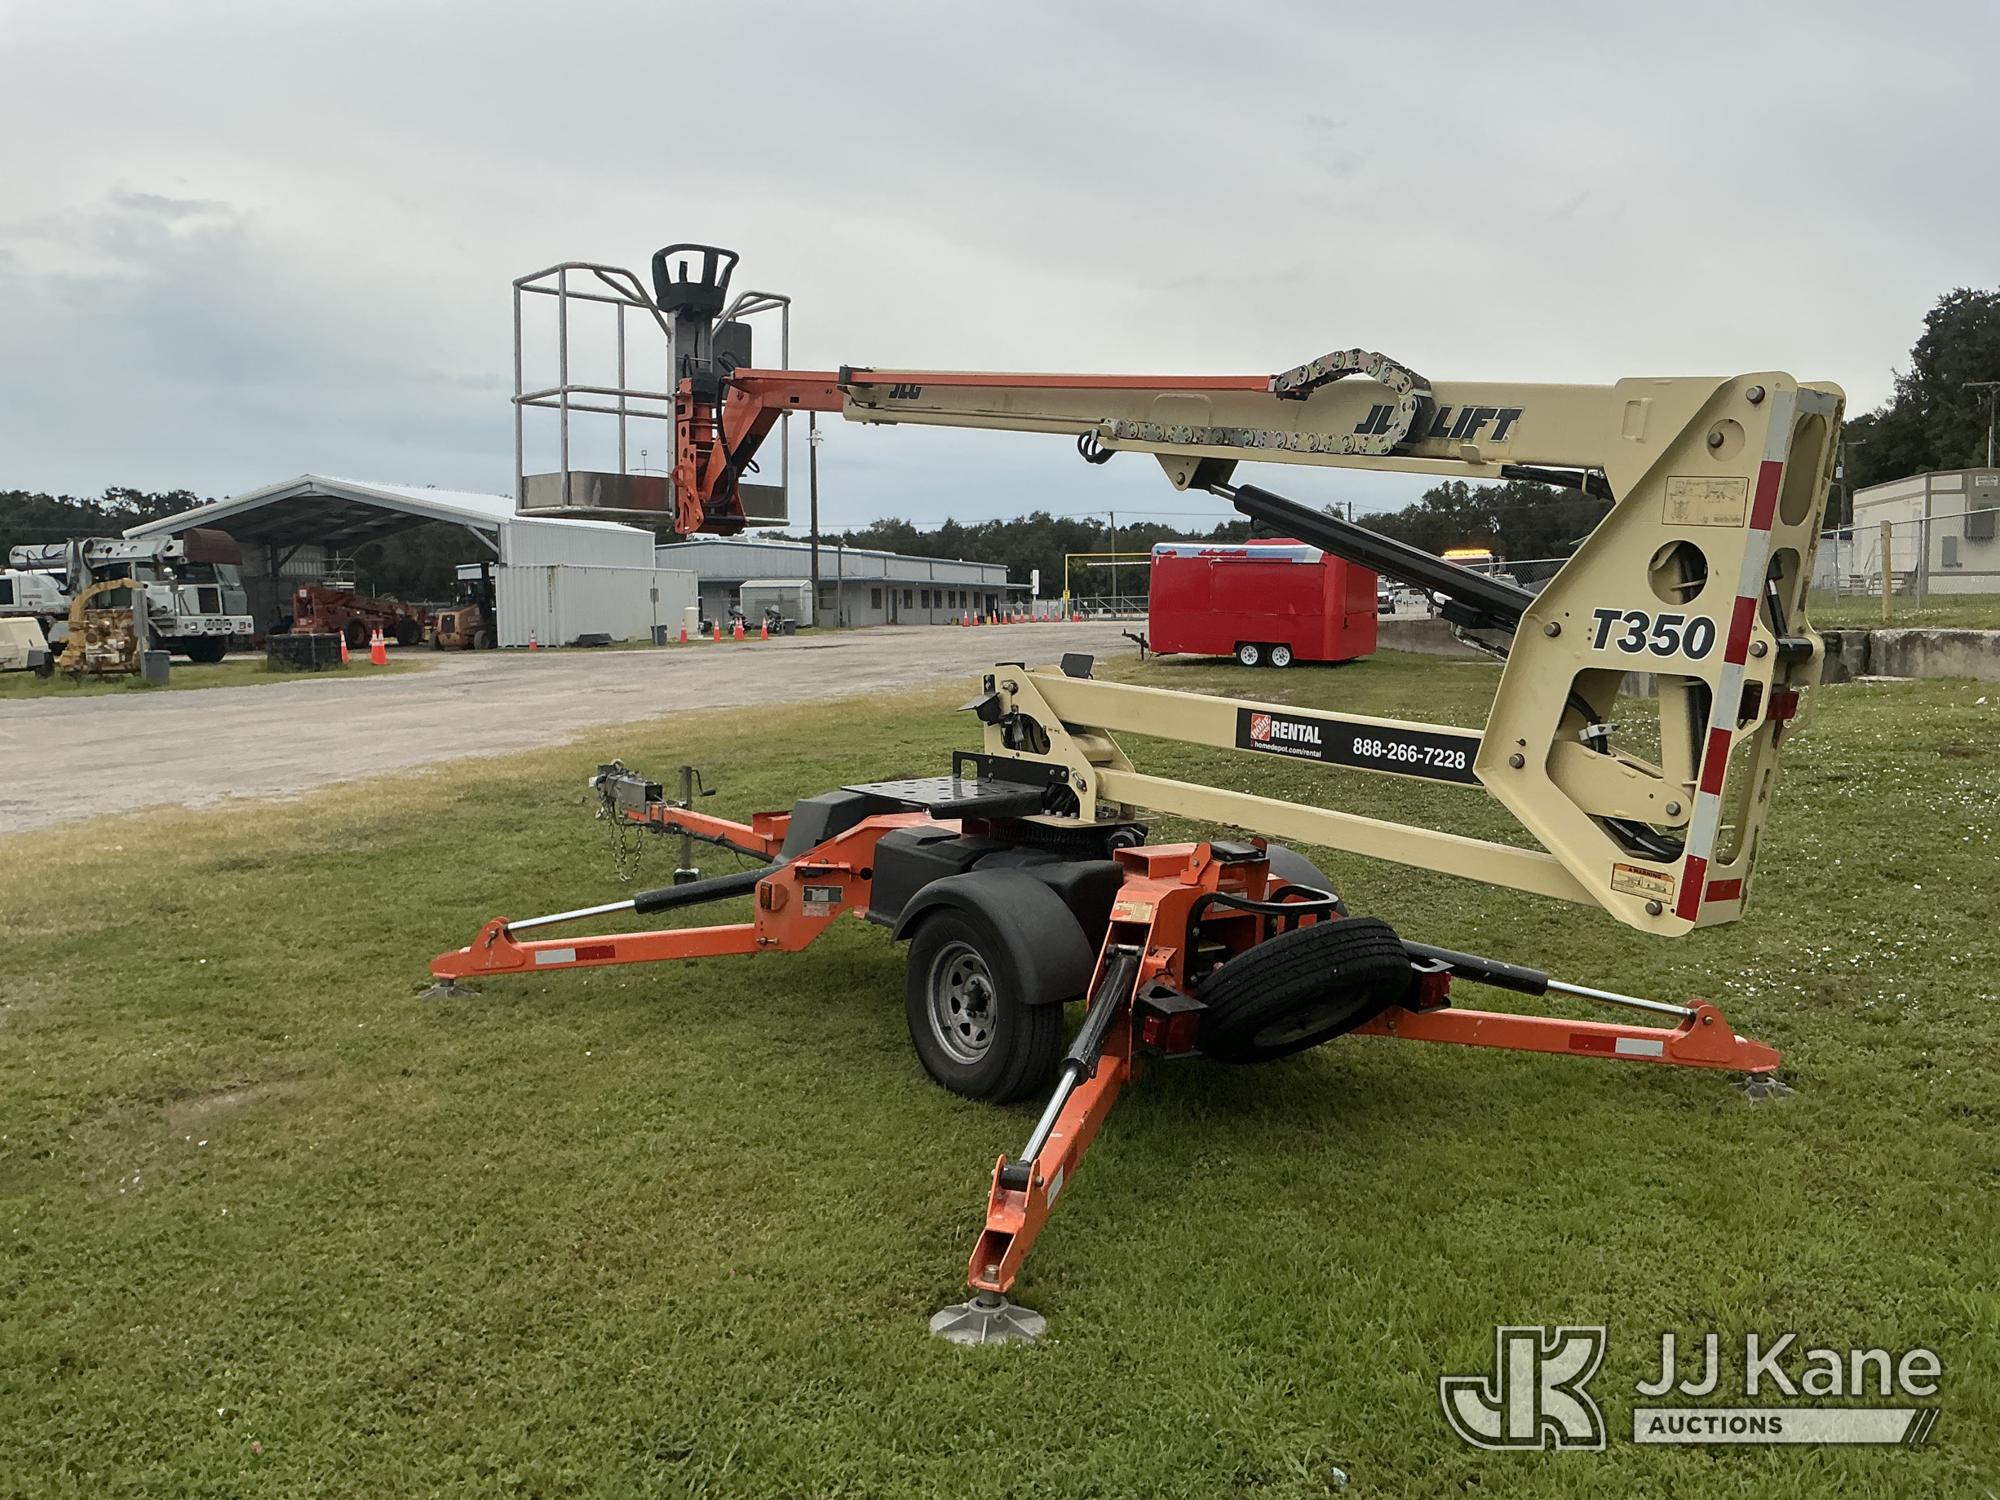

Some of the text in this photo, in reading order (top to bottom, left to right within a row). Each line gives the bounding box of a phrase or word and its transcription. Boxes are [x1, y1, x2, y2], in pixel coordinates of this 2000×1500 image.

[888, 383, 922, 400] JLG
[1353, 404, 1524, 441] JL LIFT
[1592, 608, 1717, 661] T350
[1271, 720, 1322, 745] RENTAL
[1254, 742, 1322, 757] homedepot.com/rental
[1353, 738, 1465, 769] 888-266-7228
